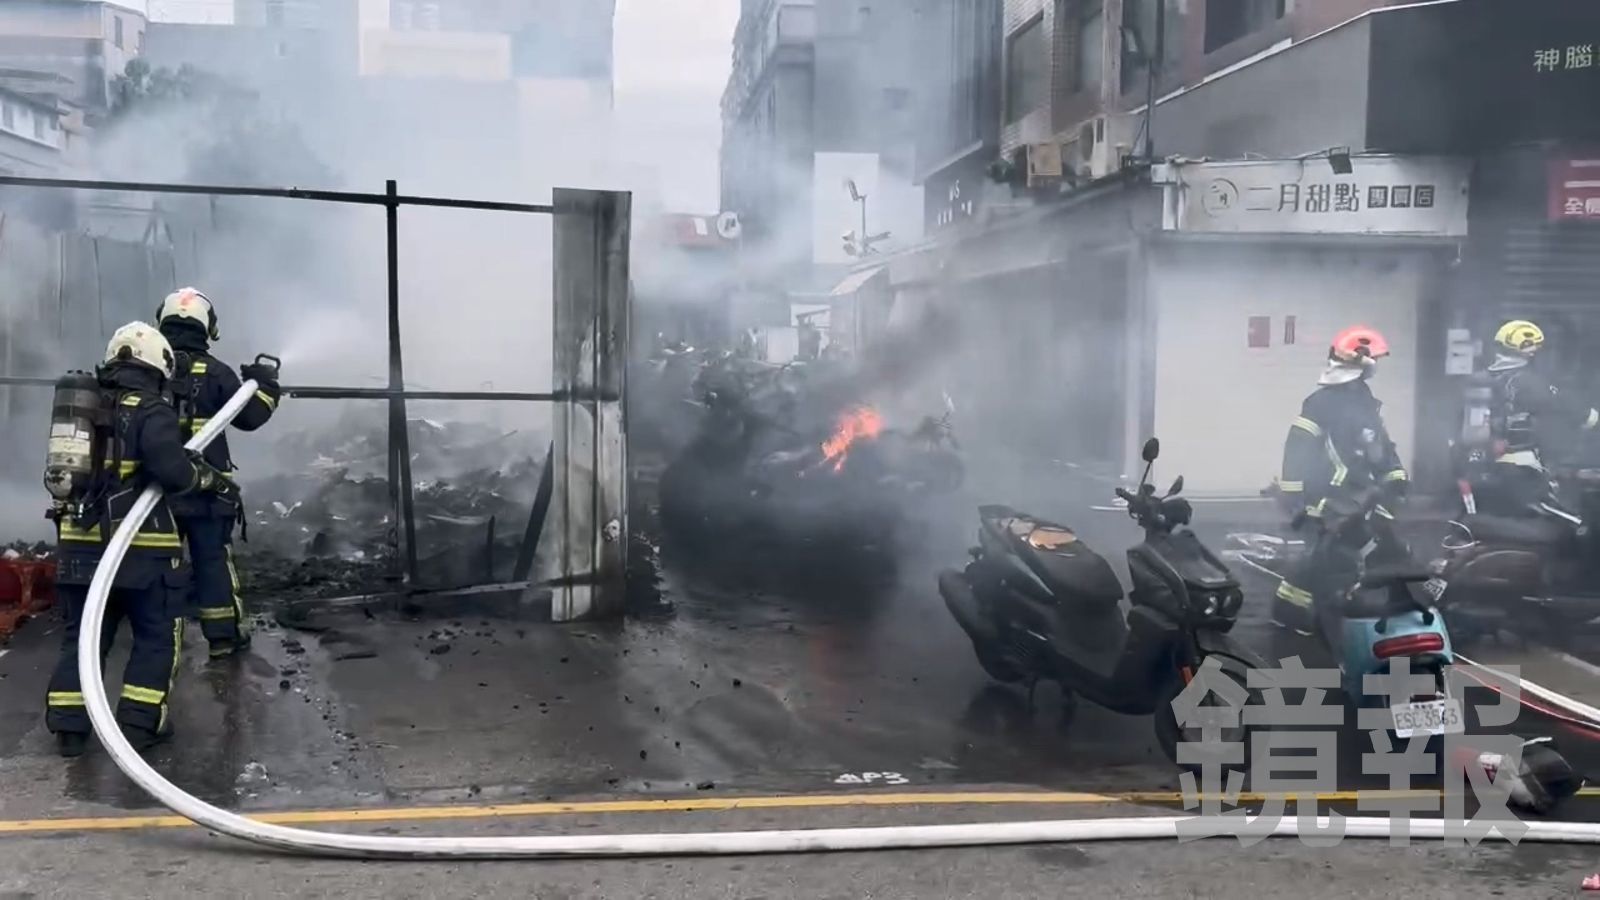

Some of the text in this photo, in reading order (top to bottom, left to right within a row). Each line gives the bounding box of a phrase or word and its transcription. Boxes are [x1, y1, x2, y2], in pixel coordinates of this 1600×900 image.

[1533, 43, 1593, 72] 神腦
[1246, 183, 1360, 213] 二月甜點
